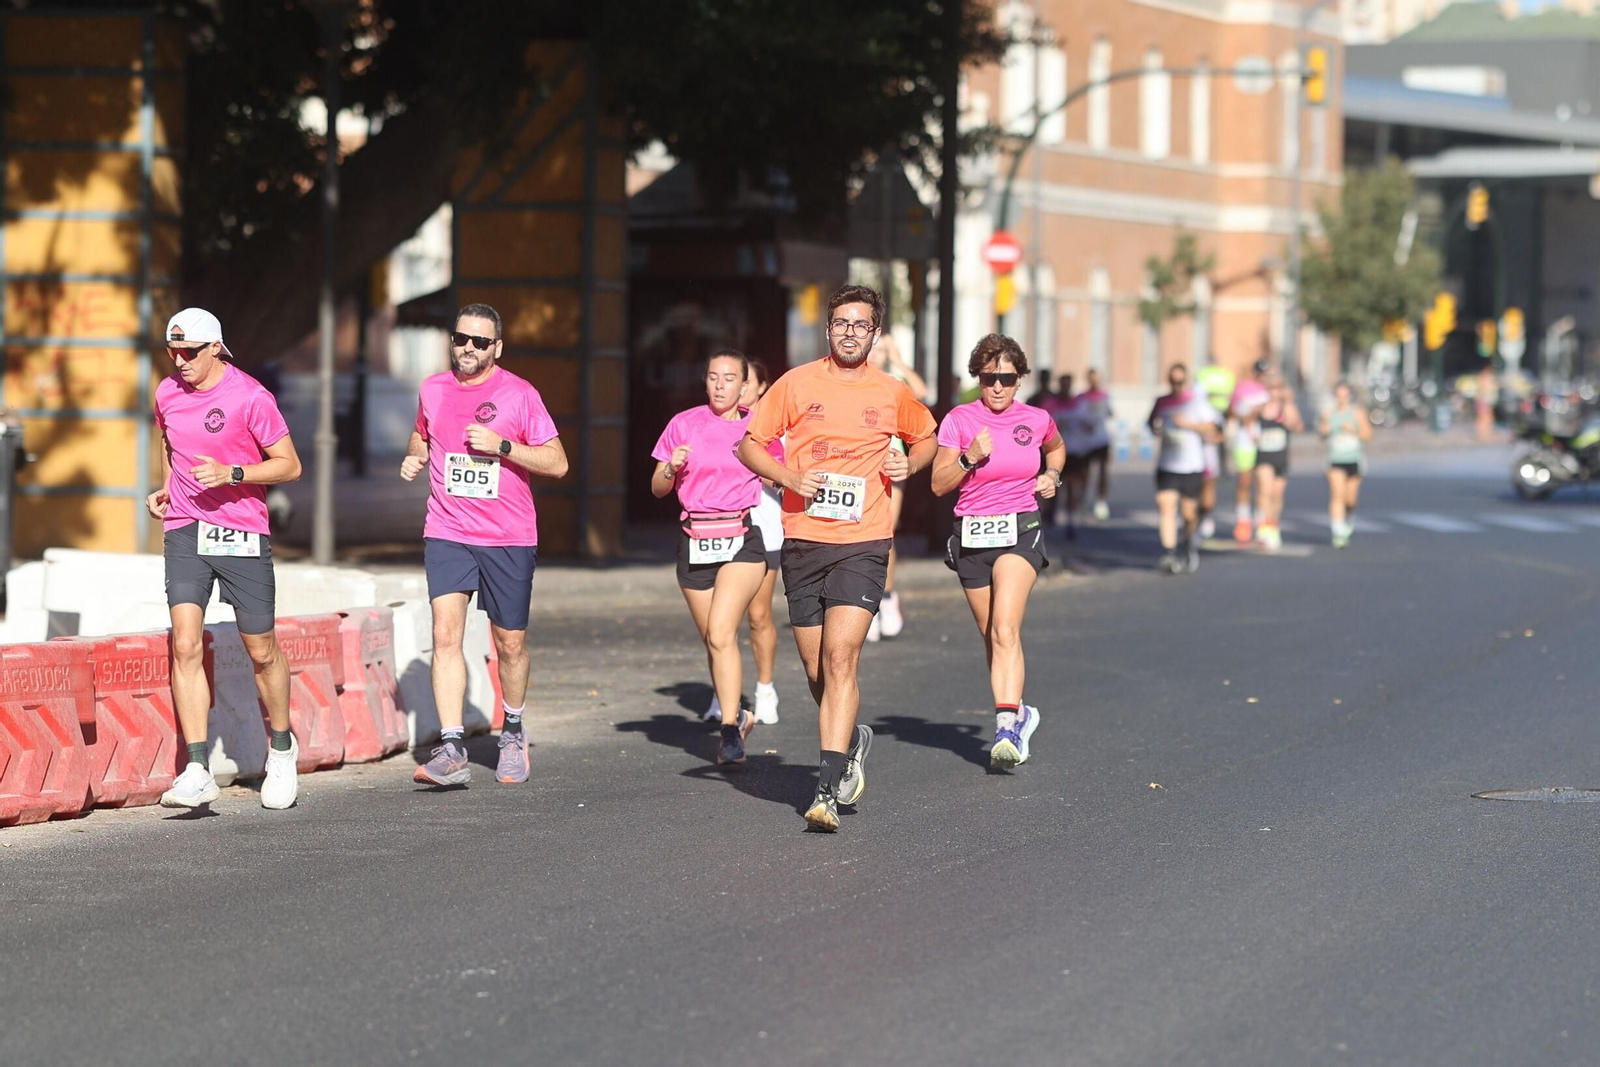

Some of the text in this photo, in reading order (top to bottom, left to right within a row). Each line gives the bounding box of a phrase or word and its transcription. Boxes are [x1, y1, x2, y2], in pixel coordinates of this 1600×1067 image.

[451, 468, 489, 485] 505
[206, 527, 248, 543] 421
[970, 520, 1009, 536] 222
[699, 537, 734, 552] 667
